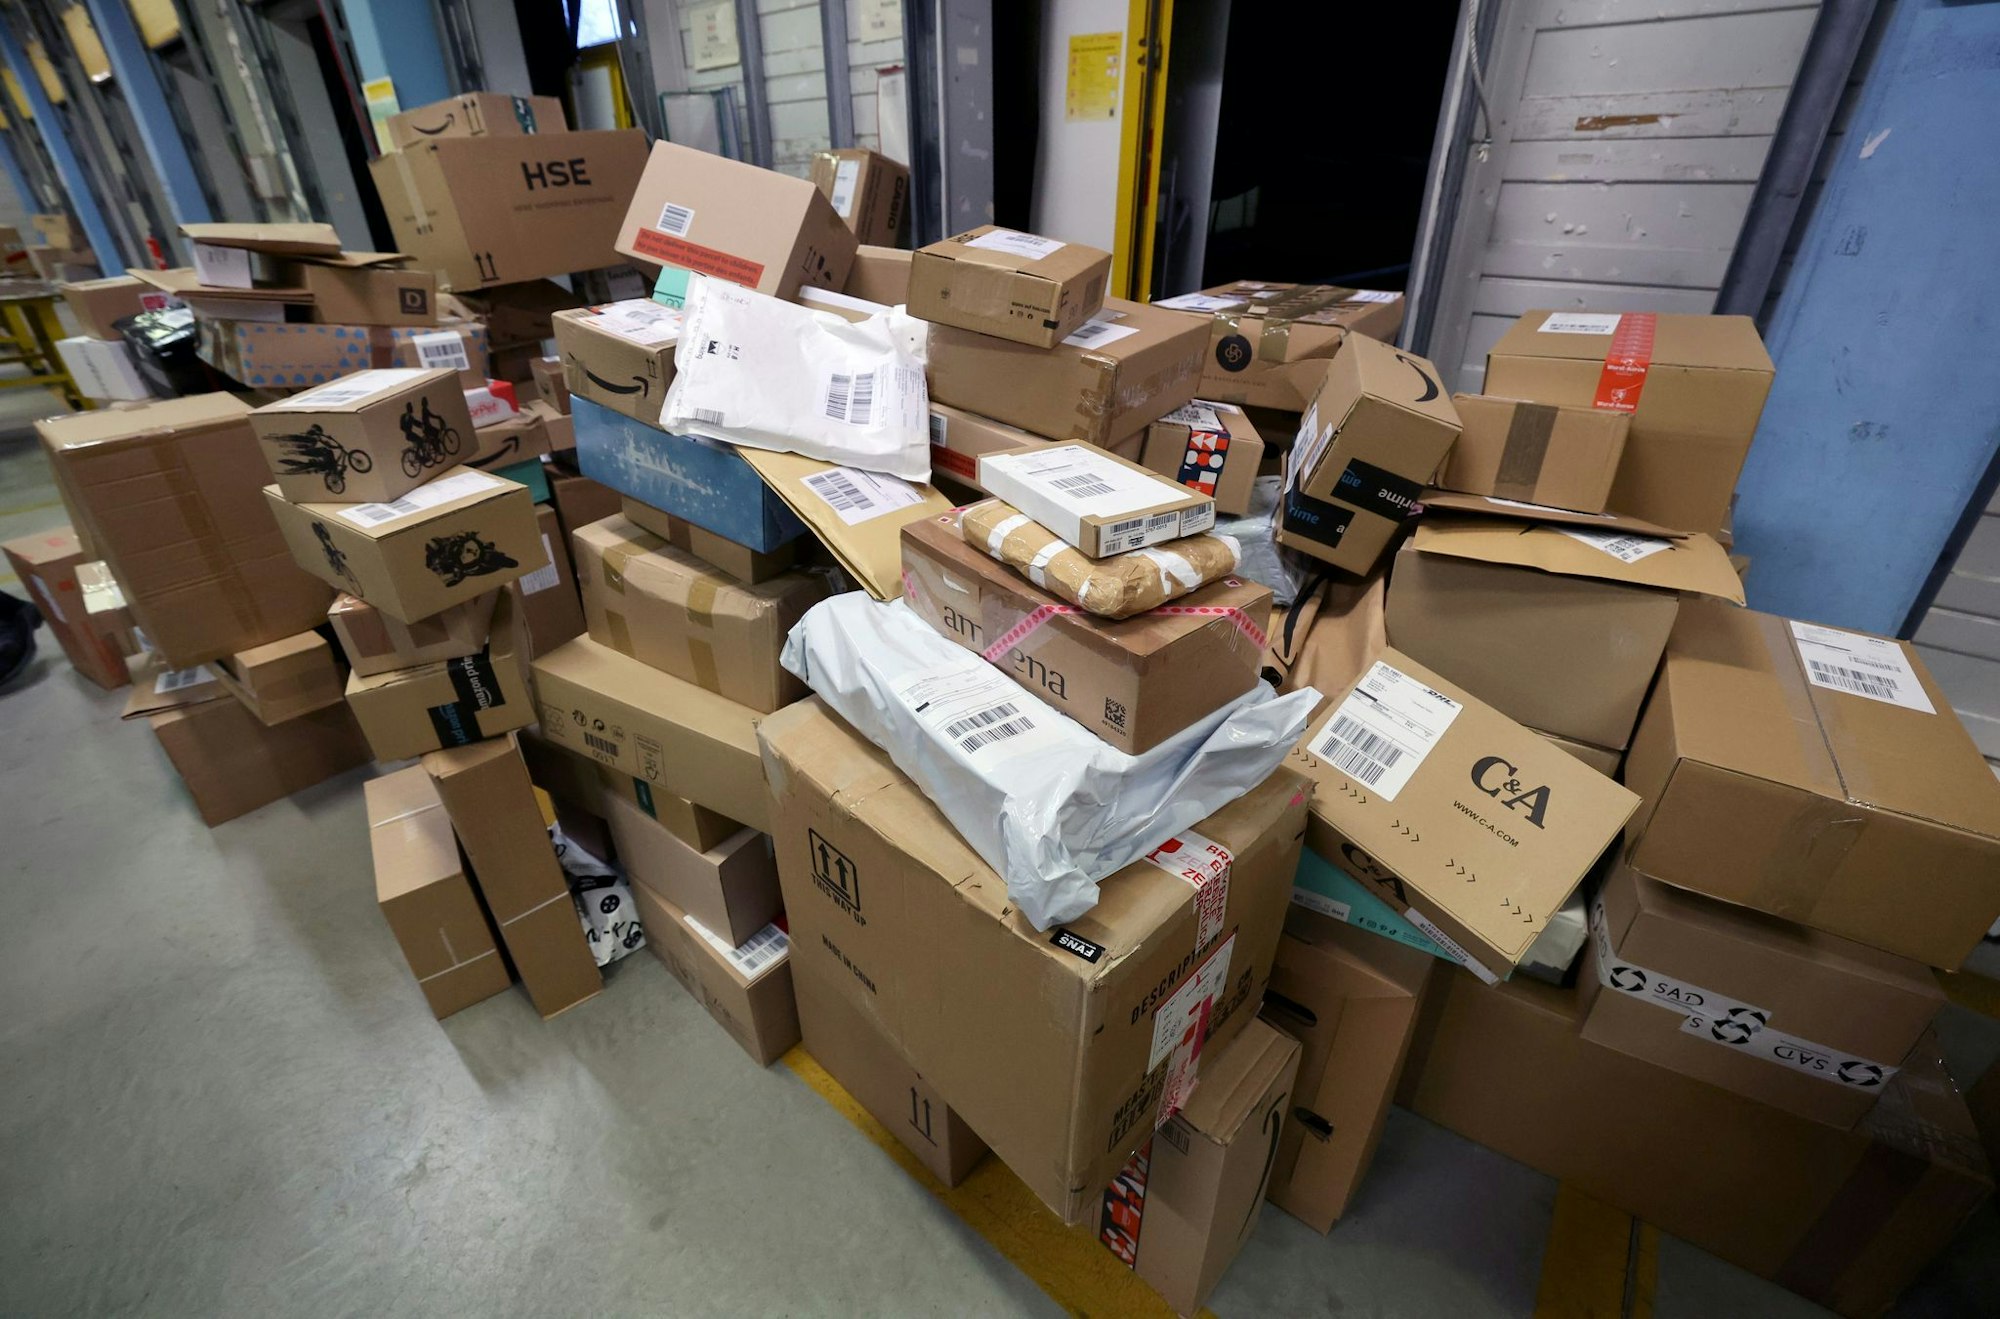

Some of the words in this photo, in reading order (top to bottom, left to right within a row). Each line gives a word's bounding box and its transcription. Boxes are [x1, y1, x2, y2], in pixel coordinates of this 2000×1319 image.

[521, 158, 592, 191] HSE
[461, 656, 479, 677] pri
[943, 605, 1068, 701] amena
[1471, 756, 1550, 830] C&A
[1453, 800, 1519, 848] WWW.C-A.COM
[811, 873, 832, 898] THIS
[833, 893, 851, 915] WAY
[853, 911, 867, 927] UP
[822, 934, 842, 961] MADE
[843, 954, 852, 970] IN
[853, 964, 877, 995] CHINA
